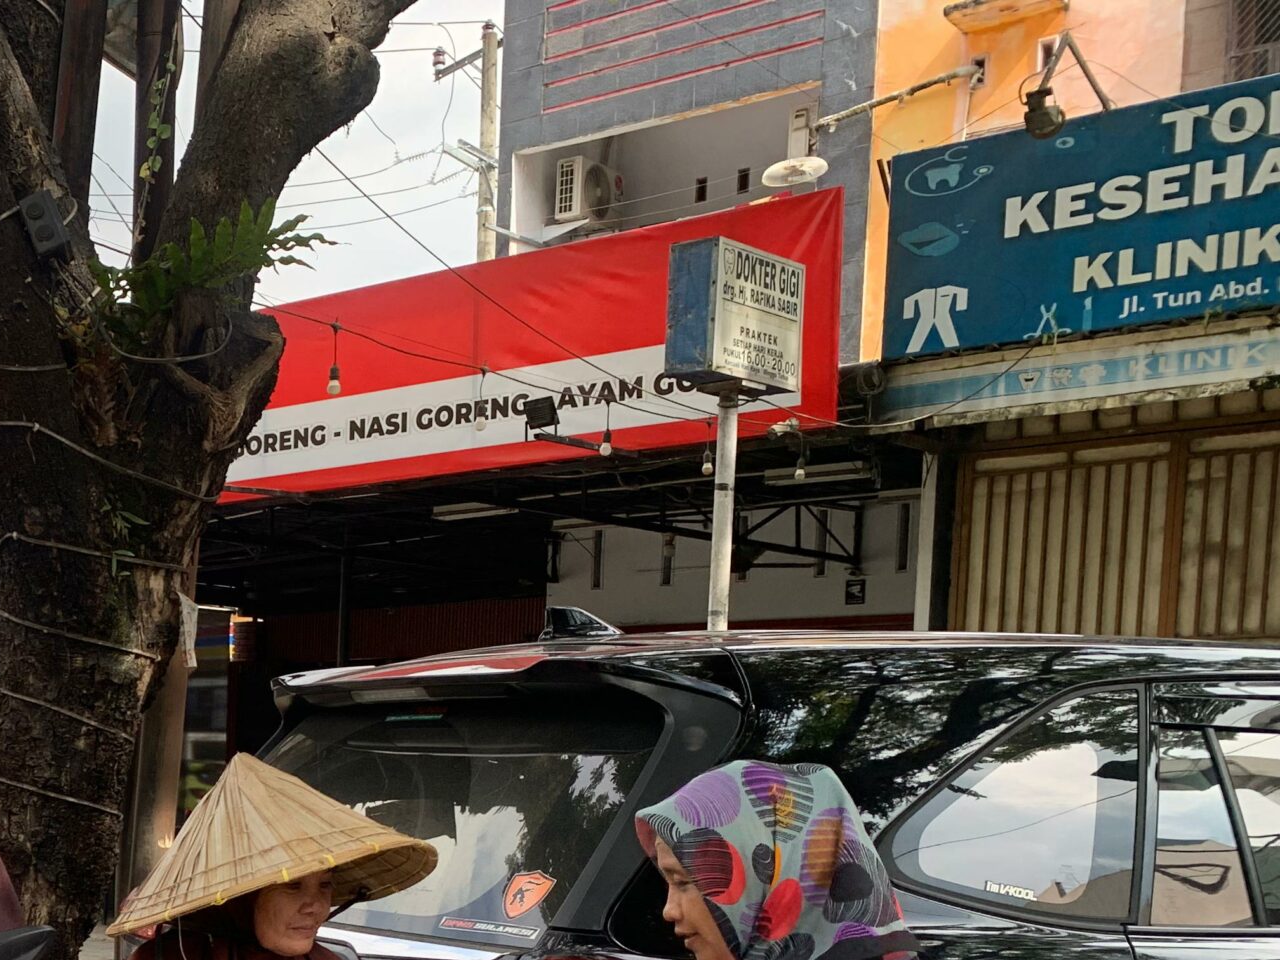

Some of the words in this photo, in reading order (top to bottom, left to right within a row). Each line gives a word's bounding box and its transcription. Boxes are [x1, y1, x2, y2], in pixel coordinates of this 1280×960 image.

[736, 251, 776, 292] DOKTER
[779, 266, 800, 299] GIGI
[1073, 223, 1280, 292] KLINIK
[750, 289, 776, 310] RAFIKA
[777, 297, 798, 317] SABIR
[1118, 295, 1145, 319] Jl.
[1152, 290, 1202, 309] Tun
[1208, 277, 1270, 302] Abd.
[723, 347, 741, 360] PUKUL
[732, 338, 752, 350] SETIAP
[753, 344, 766, 354] HARI
[767, 348, 784, 359] KERJA
[740, 326, 778, 346] PRAKTEK
[1129, 343, 1267, 378] KLINIK
[348, 411, 408, 441] NASI
[416, 393, 530, 431] GORENG
[557, 375, 644, 410] AYAM
